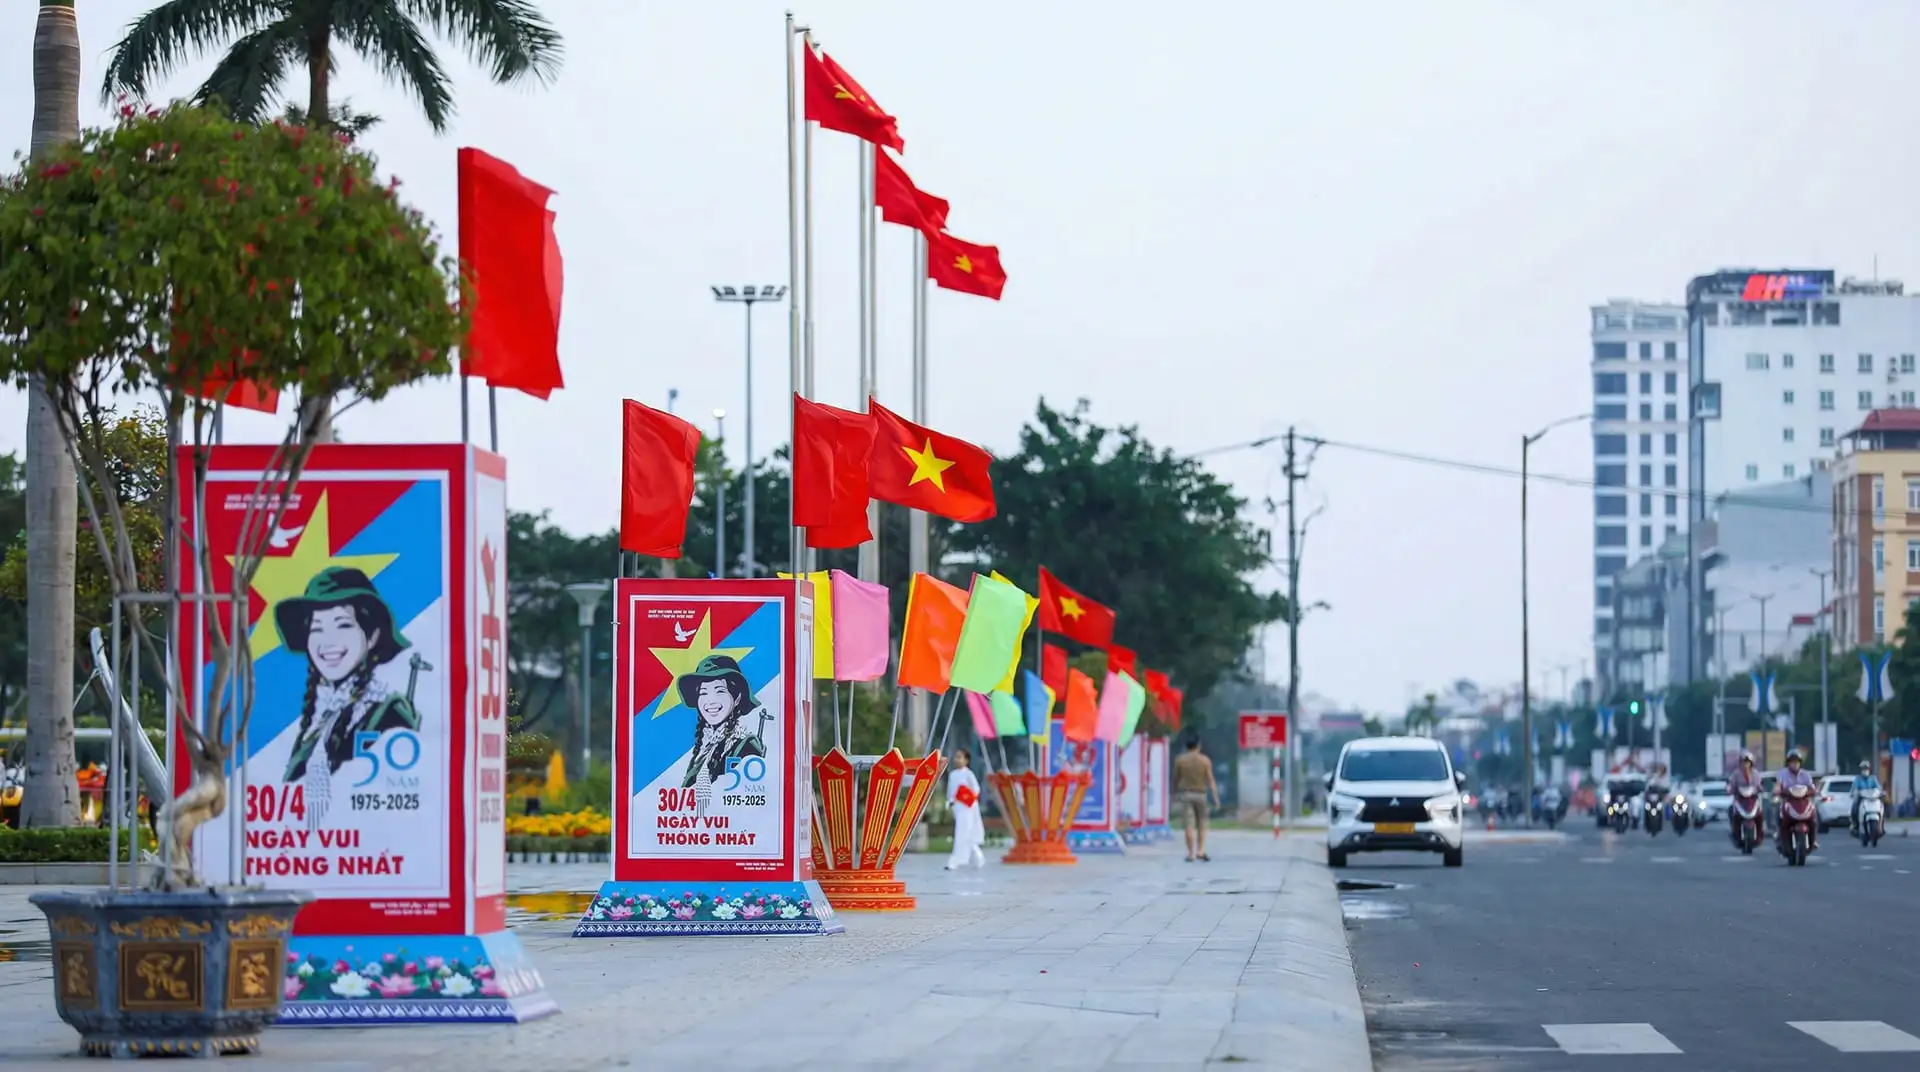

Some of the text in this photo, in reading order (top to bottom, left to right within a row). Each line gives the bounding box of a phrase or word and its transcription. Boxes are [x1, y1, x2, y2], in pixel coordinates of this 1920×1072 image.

[352, 730, 420, 788] 50
[724, 756, 766, 792] 50
[245, 784, 305, 822] 30/4
[351, 793, 420, 811] 1975-2025
[658, 788, 696, 812] 30/4
[722, 795, 766, 806] 1975-2025
[657, 813, 729, 828] NGÀY VUI
[246, 825, 360, 848] NGÀY VUI
[657, 829, 756, 845] THỐNG NHẤT
[245, 847, 404, 875] THỐNG NHẤT
